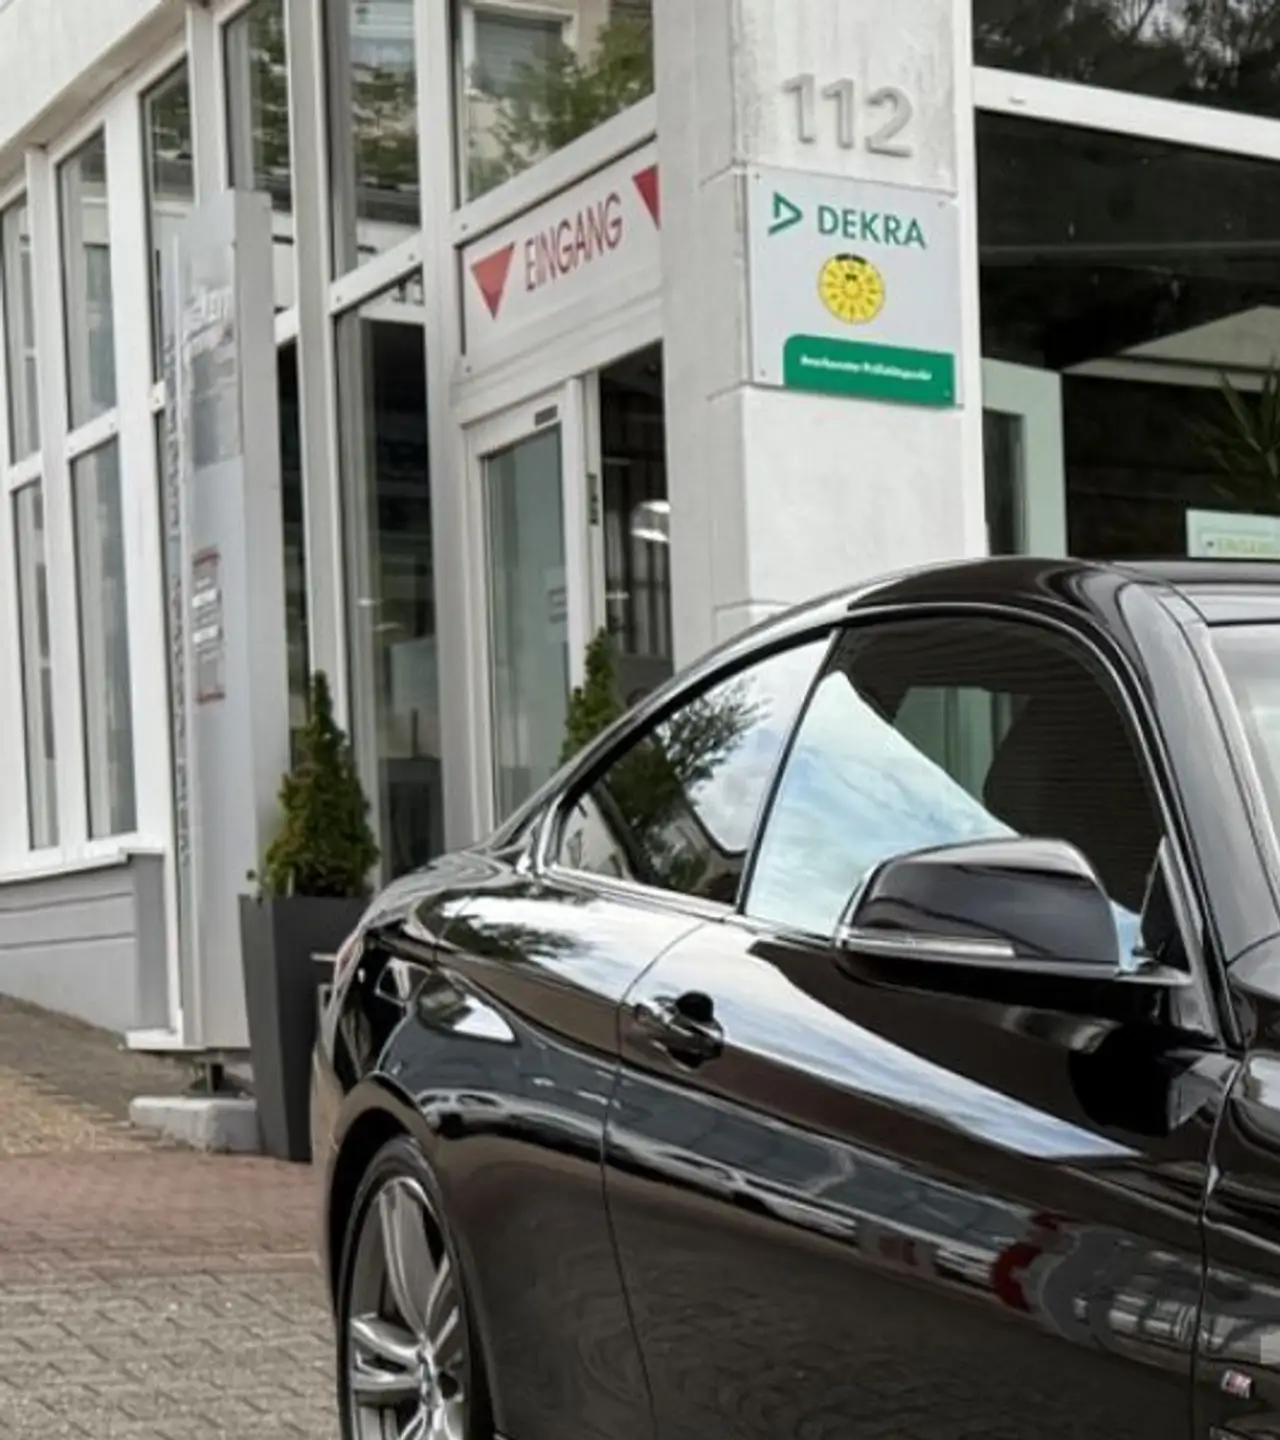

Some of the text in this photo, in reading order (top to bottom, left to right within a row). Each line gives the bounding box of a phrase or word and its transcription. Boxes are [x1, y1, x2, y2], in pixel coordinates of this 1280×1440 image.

[782, 73, 914, 158] 112
[524, 191, 623, 292] EINGANG
[817, 204, 927, 250] DEKRA
